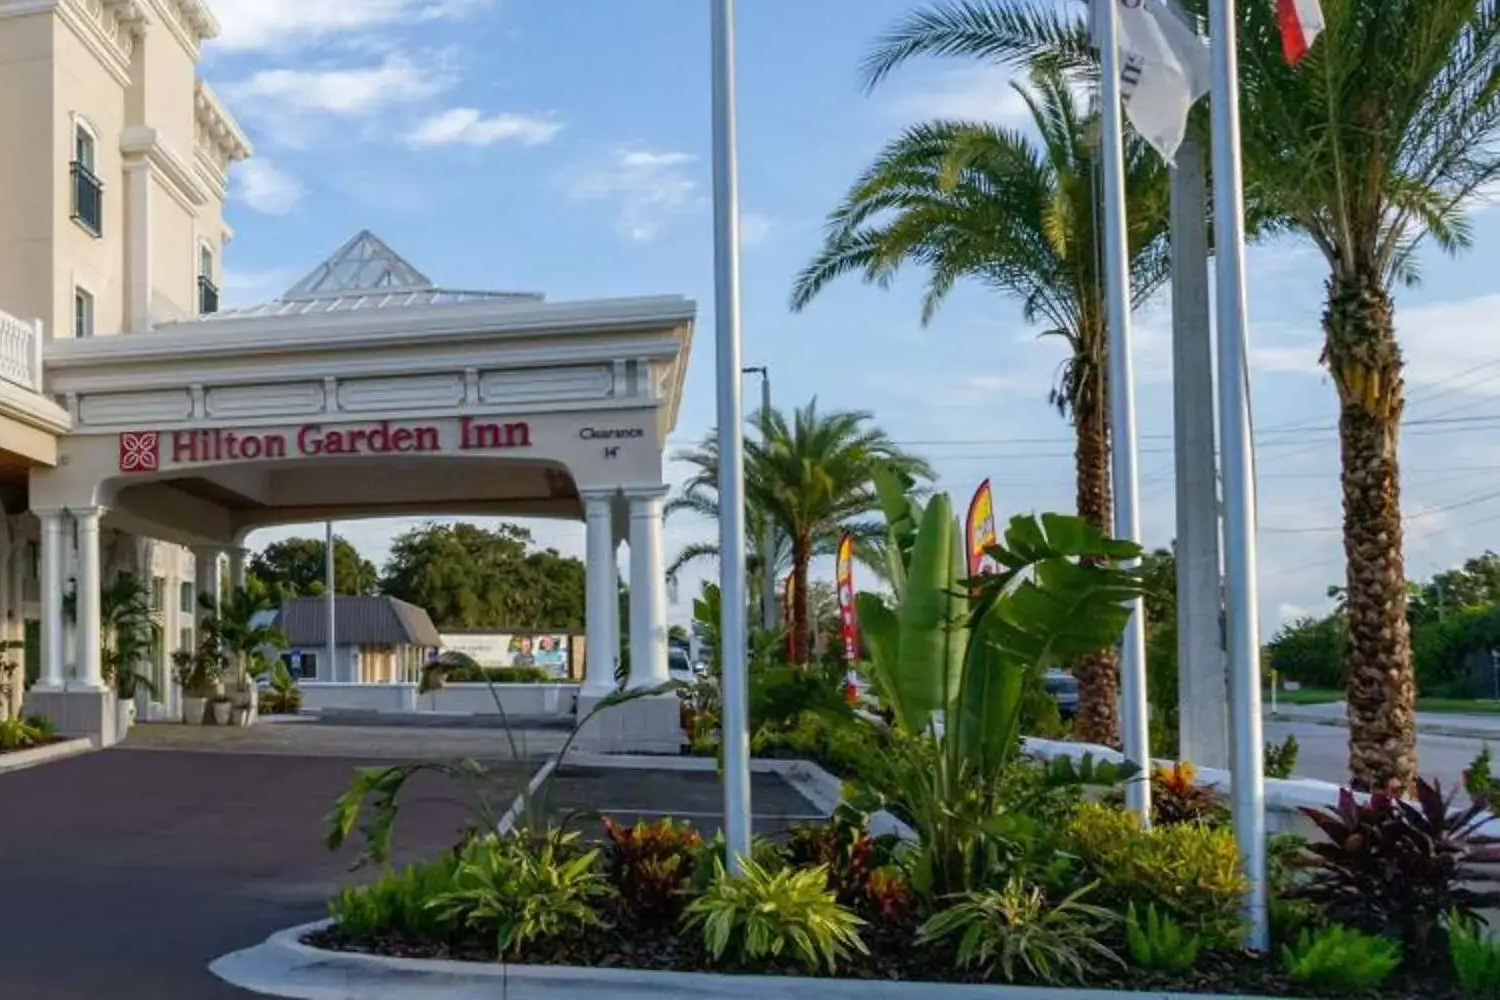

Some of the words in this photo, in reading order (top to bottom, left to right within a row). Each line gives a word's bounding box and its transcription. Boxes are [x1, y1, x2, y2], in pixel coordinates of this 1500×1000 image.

[171, 427, 286, 462] Hilton
[297, 420, 441, 455] Garden
[459, 415, 532, 450] Inn
[579, 427, 644, 440] Clearance
